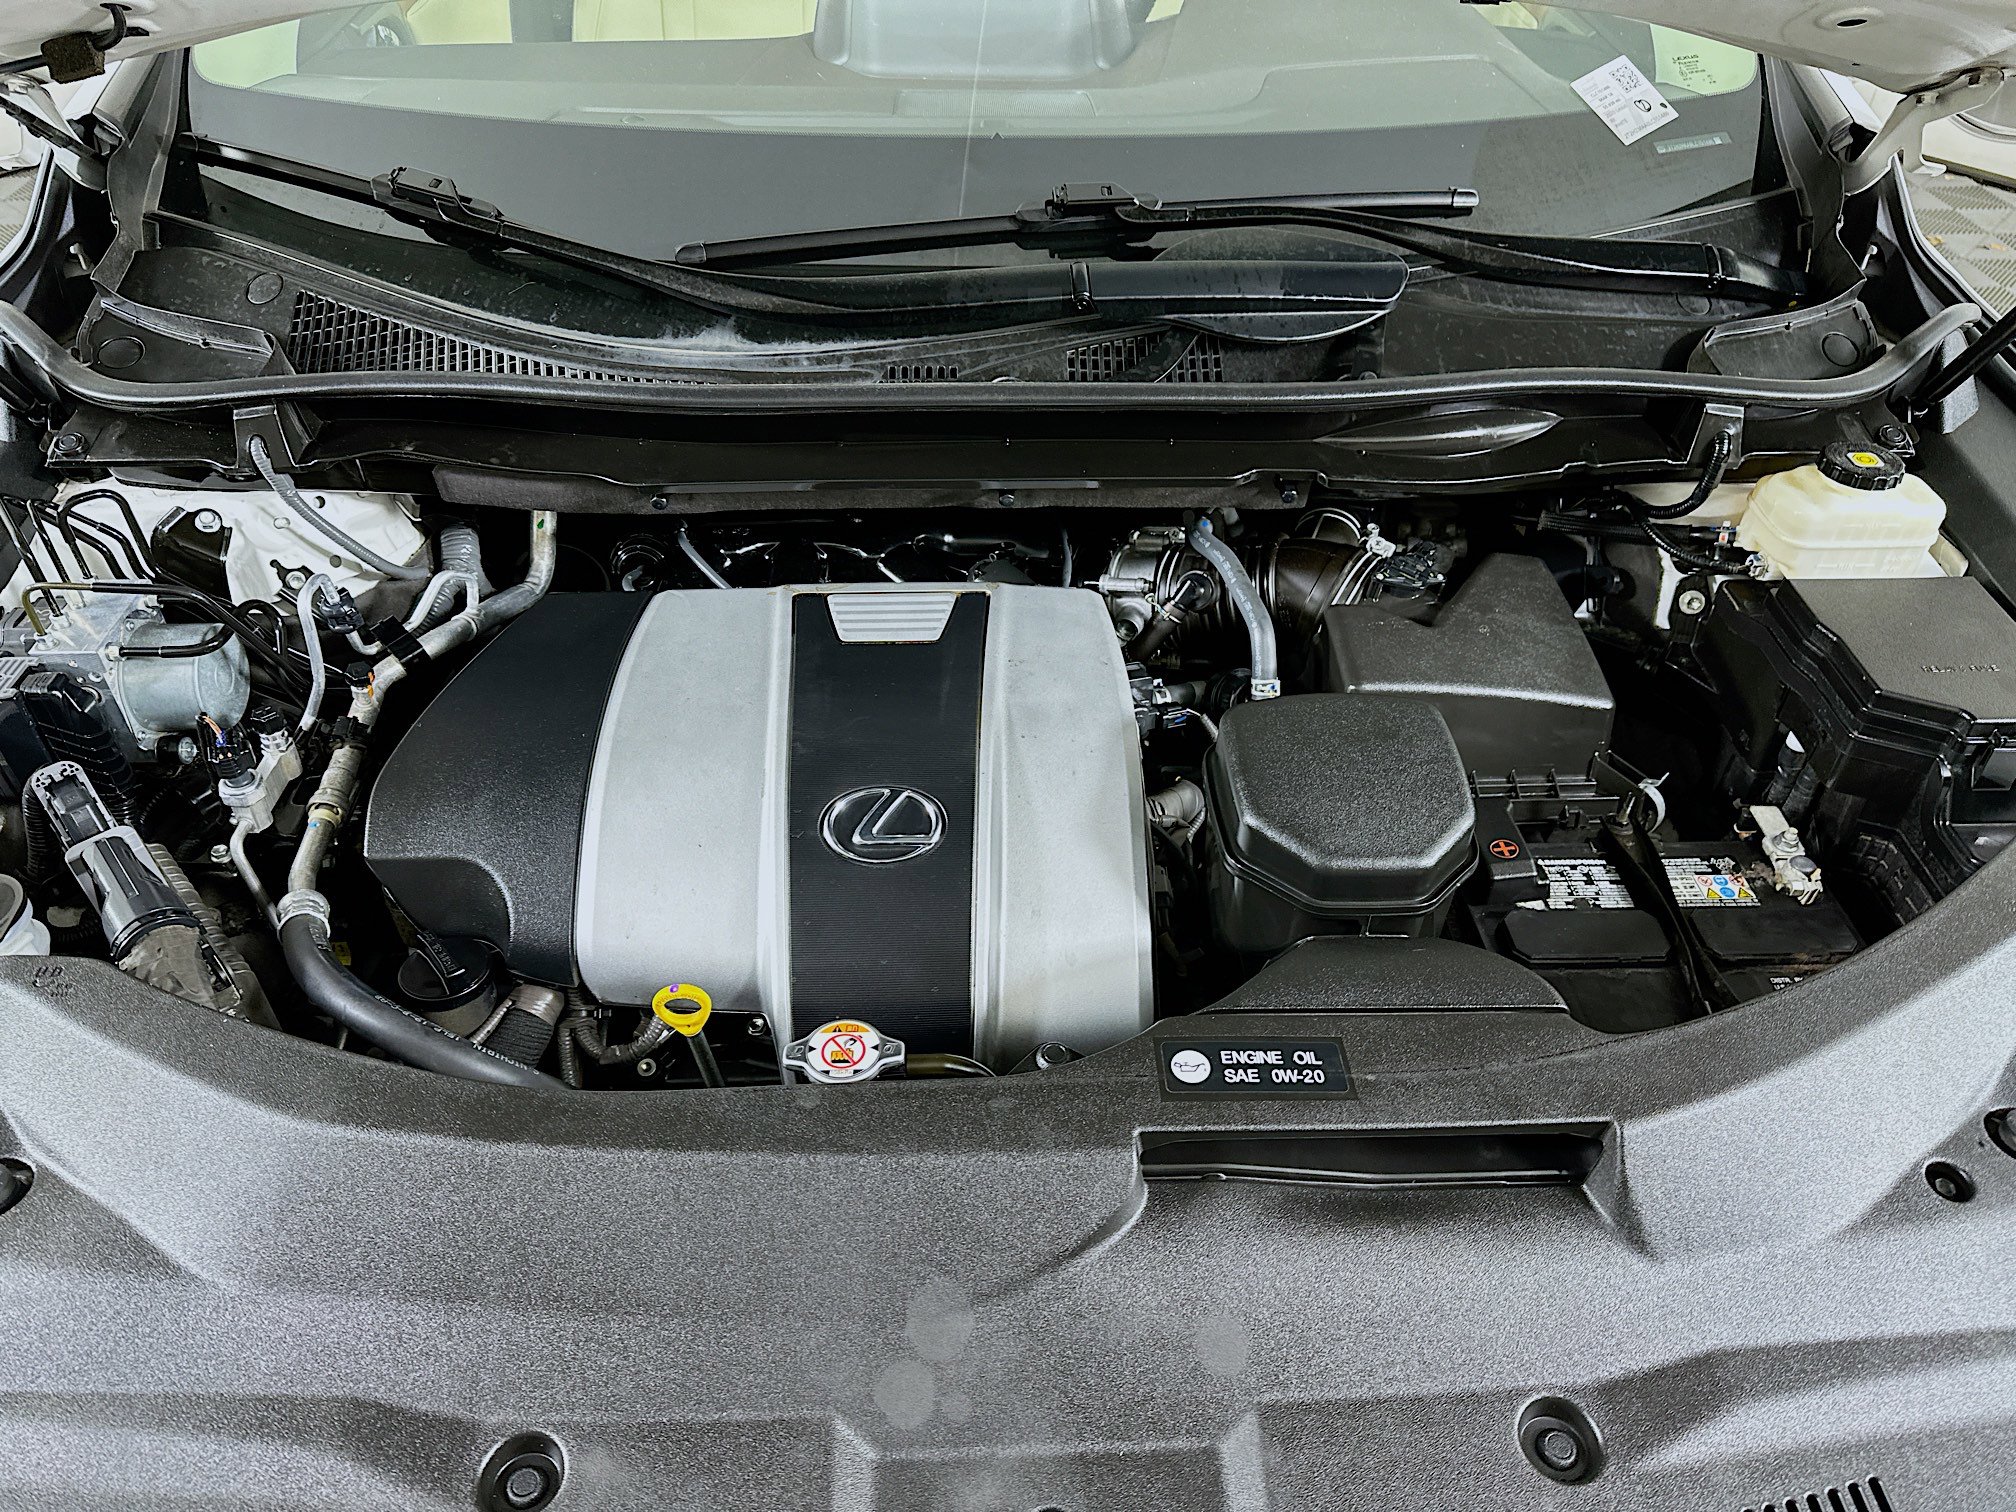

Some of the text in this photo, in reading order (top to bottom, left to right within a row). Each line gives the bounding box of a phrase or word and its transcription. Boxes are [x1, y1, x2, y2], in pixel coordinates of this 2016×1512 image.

[1220, 1050, 1323, 1065] ENGINE OIL
[1224, 1069, 1325, 1084] SAE 0W-20
